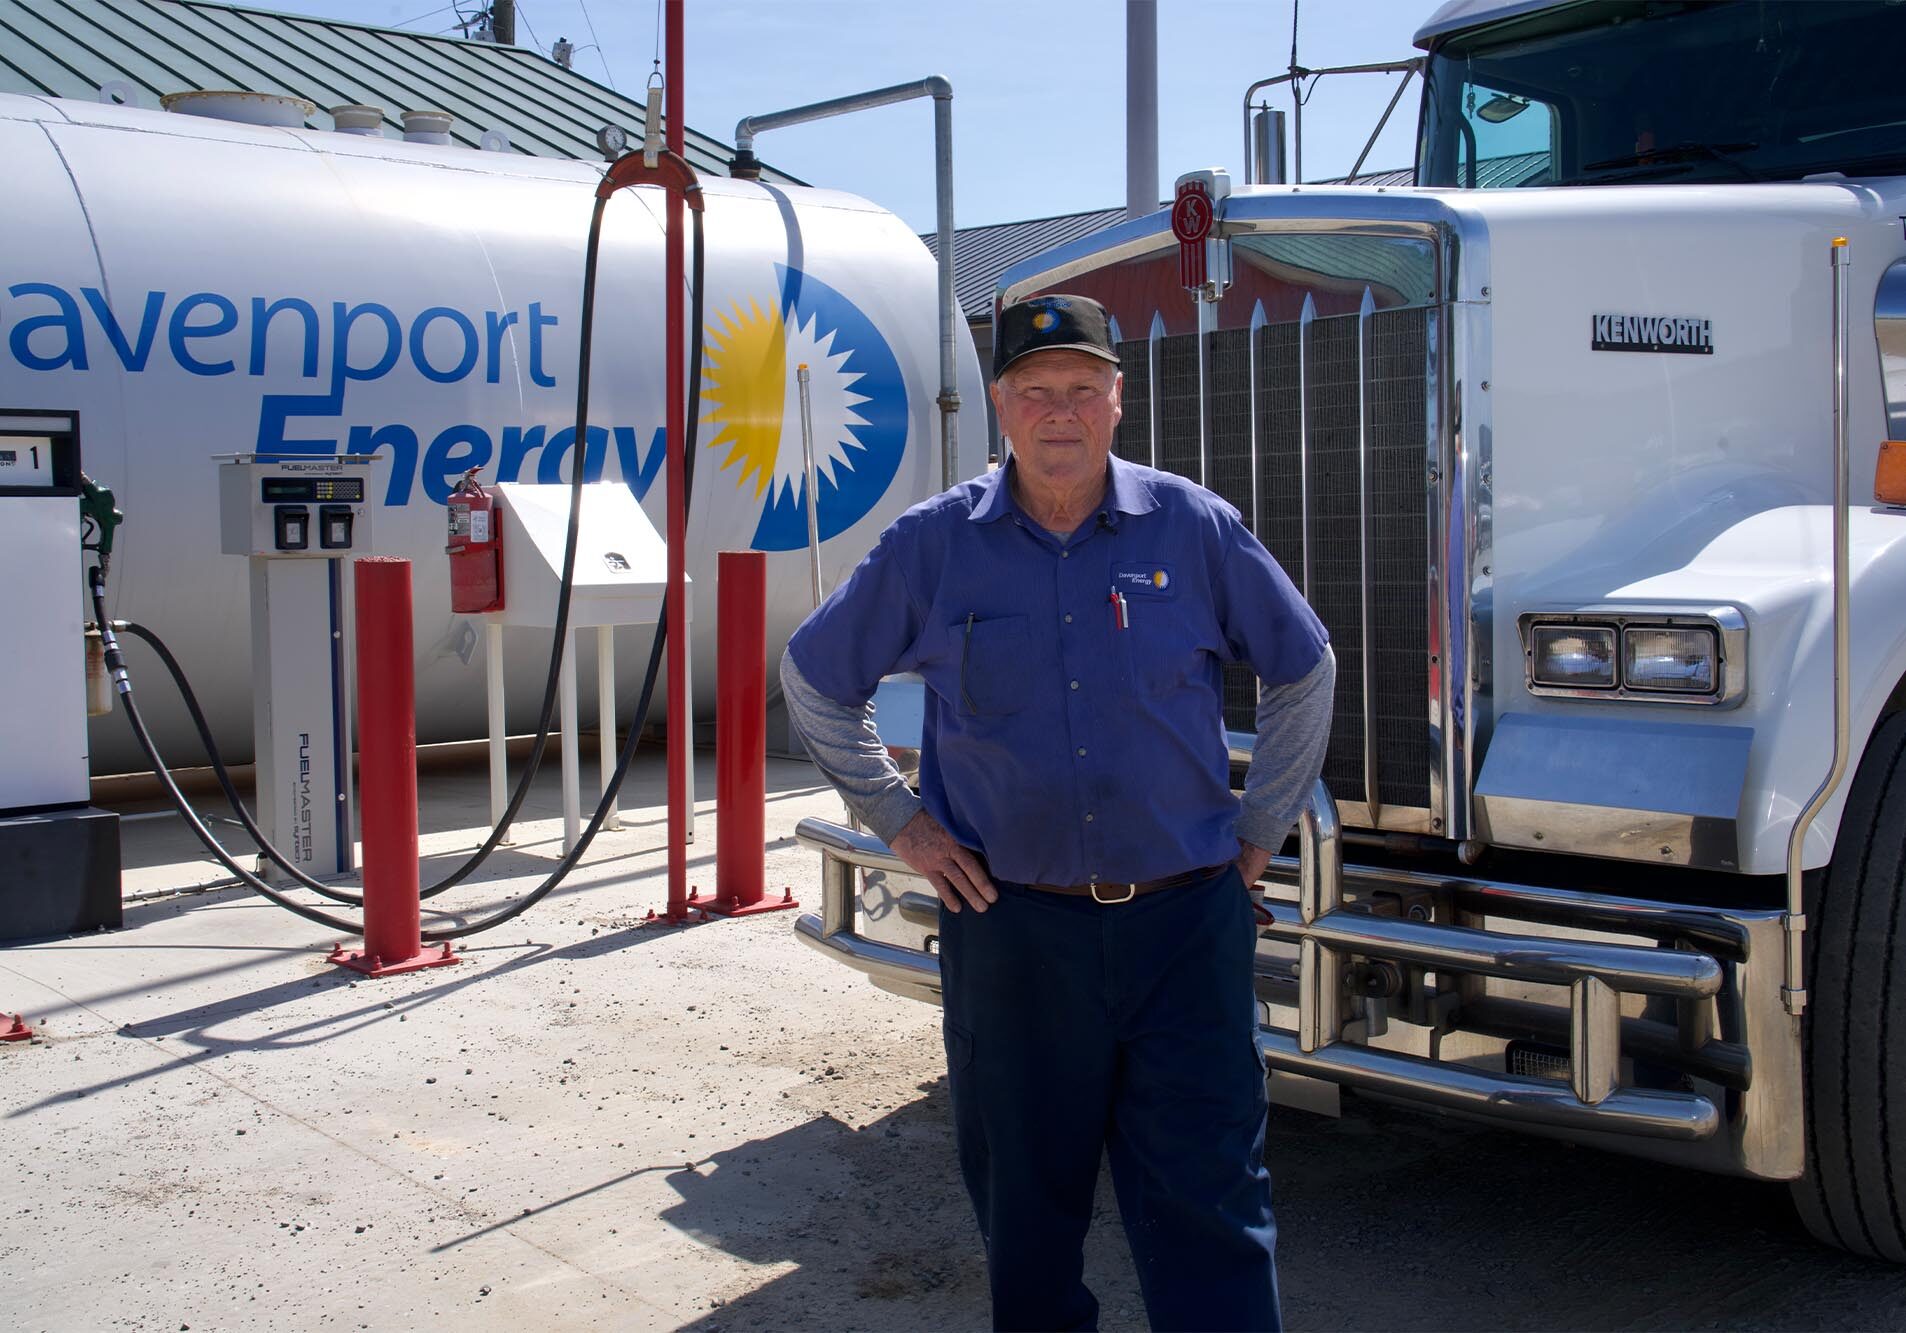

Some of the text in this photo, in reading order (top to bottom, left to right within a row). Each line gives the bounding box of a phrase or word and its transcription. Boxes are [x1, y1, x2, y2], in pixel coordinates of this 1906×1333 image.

[0, 282, 558, 396] avenport
[1594, 315, 1713, 346] KENWORTH
[30, 446, 39, 469] 1
[299, 733, 313, 862] FUELMASTER
